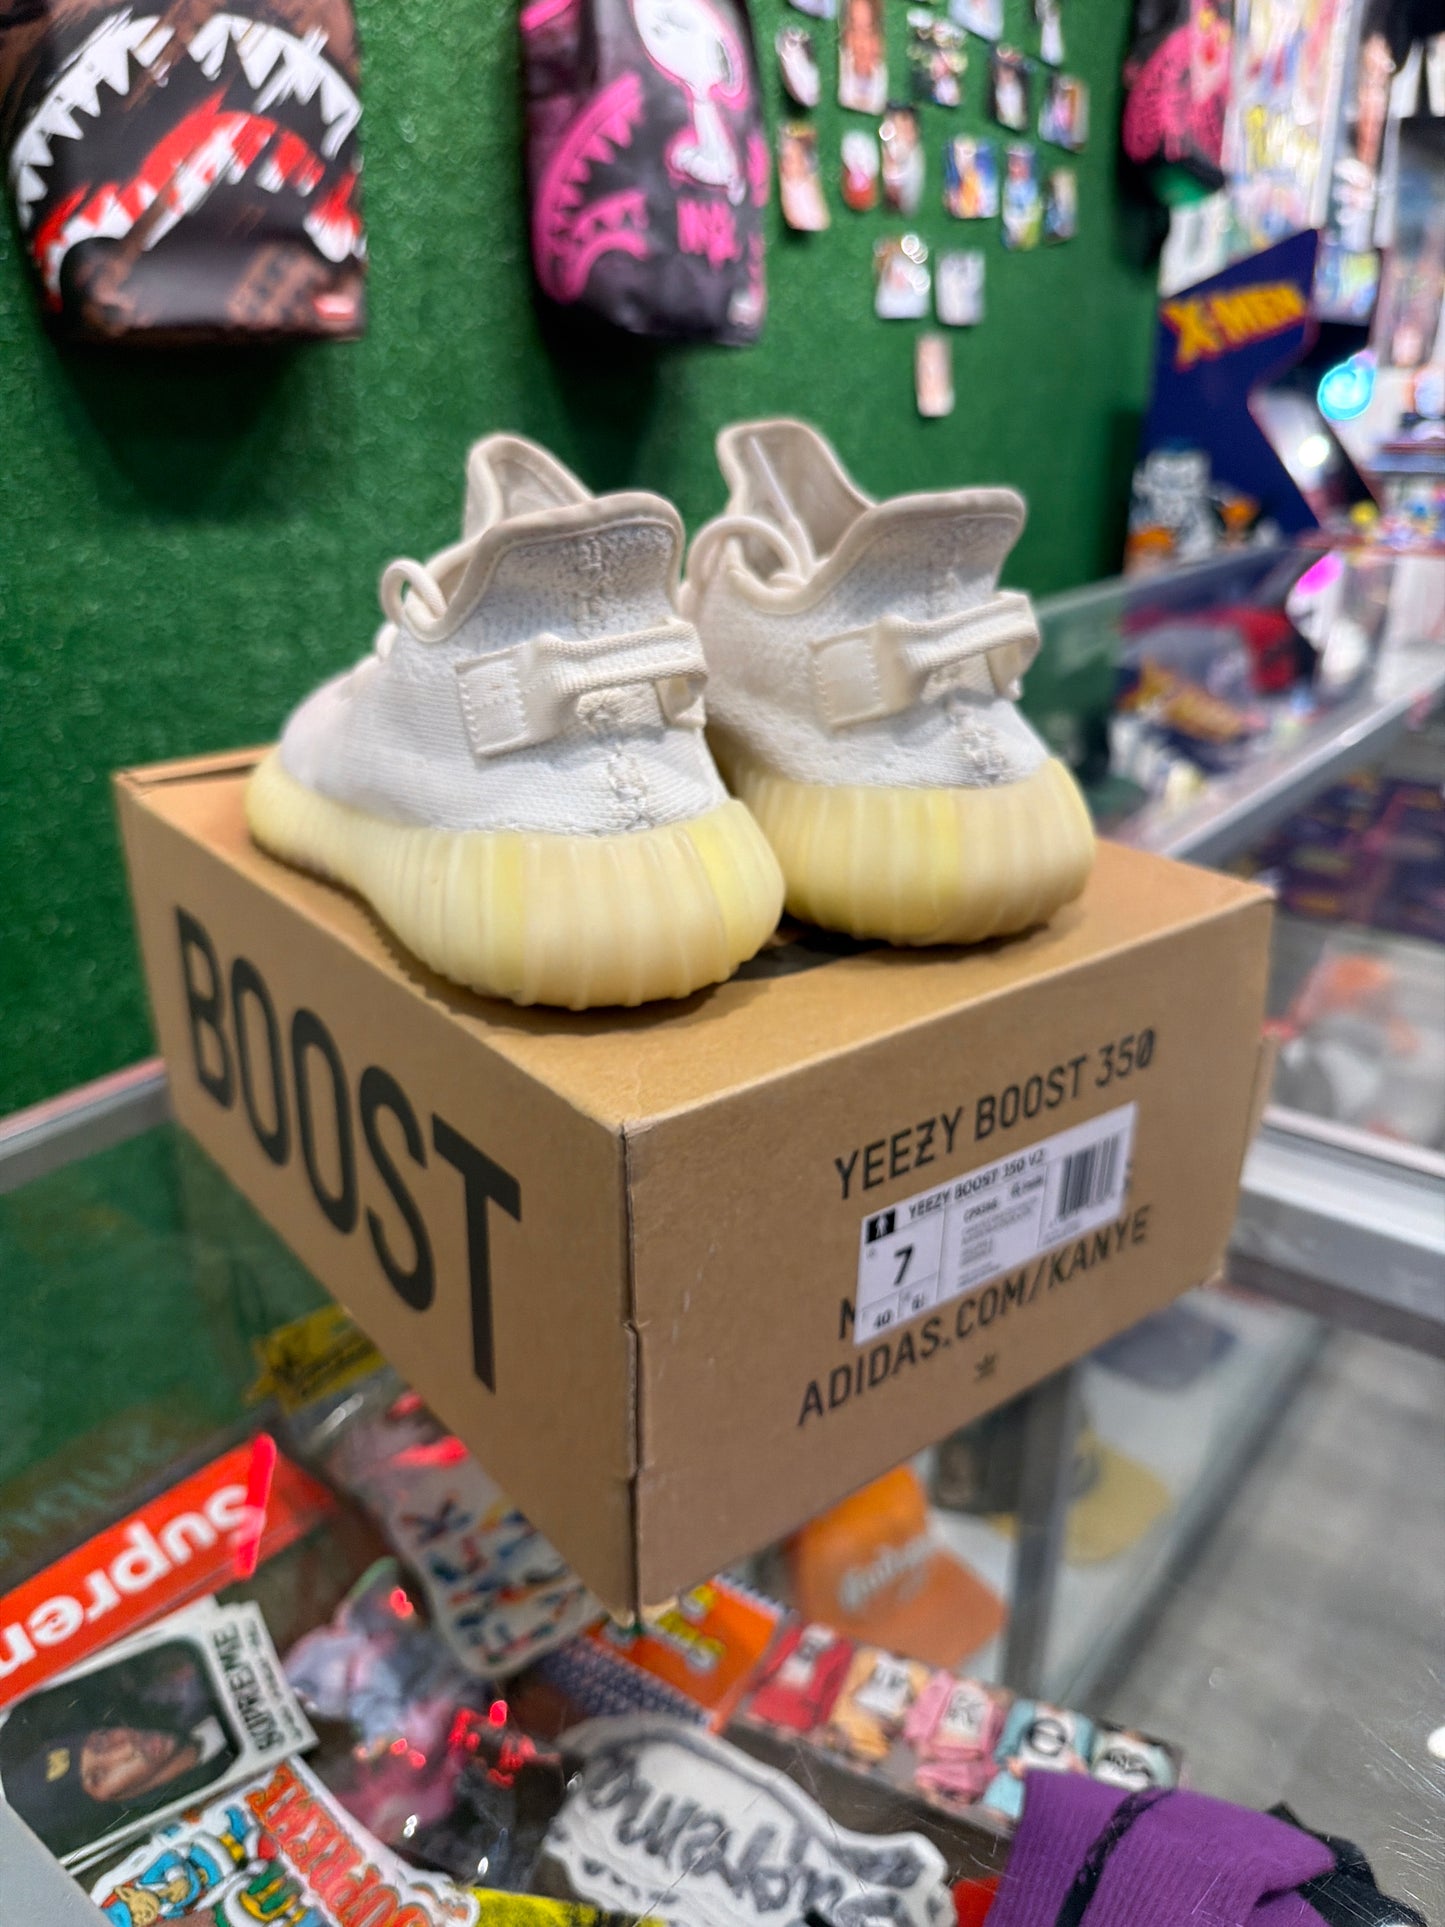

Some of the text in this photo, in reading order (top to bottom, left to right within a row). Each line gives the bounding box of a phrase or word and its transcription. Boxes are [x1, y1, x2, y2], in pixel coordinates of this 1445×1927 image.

[175, 904, 522, 1395] BOOST
[834, 1028, 1156, 1200] YEEZY BOOST 350
[908, 1187, 951, 1219] YEEZY
[954, 1167, 999, 1200] BOOST
[797, 1205, 1150, 1427] ADIDAS.COM/KANYE
[874, 1308, 892, 1330] 40
[894, 1243, 914, 1287] 7
[212, 1620, 286, 1752] SUPREME
